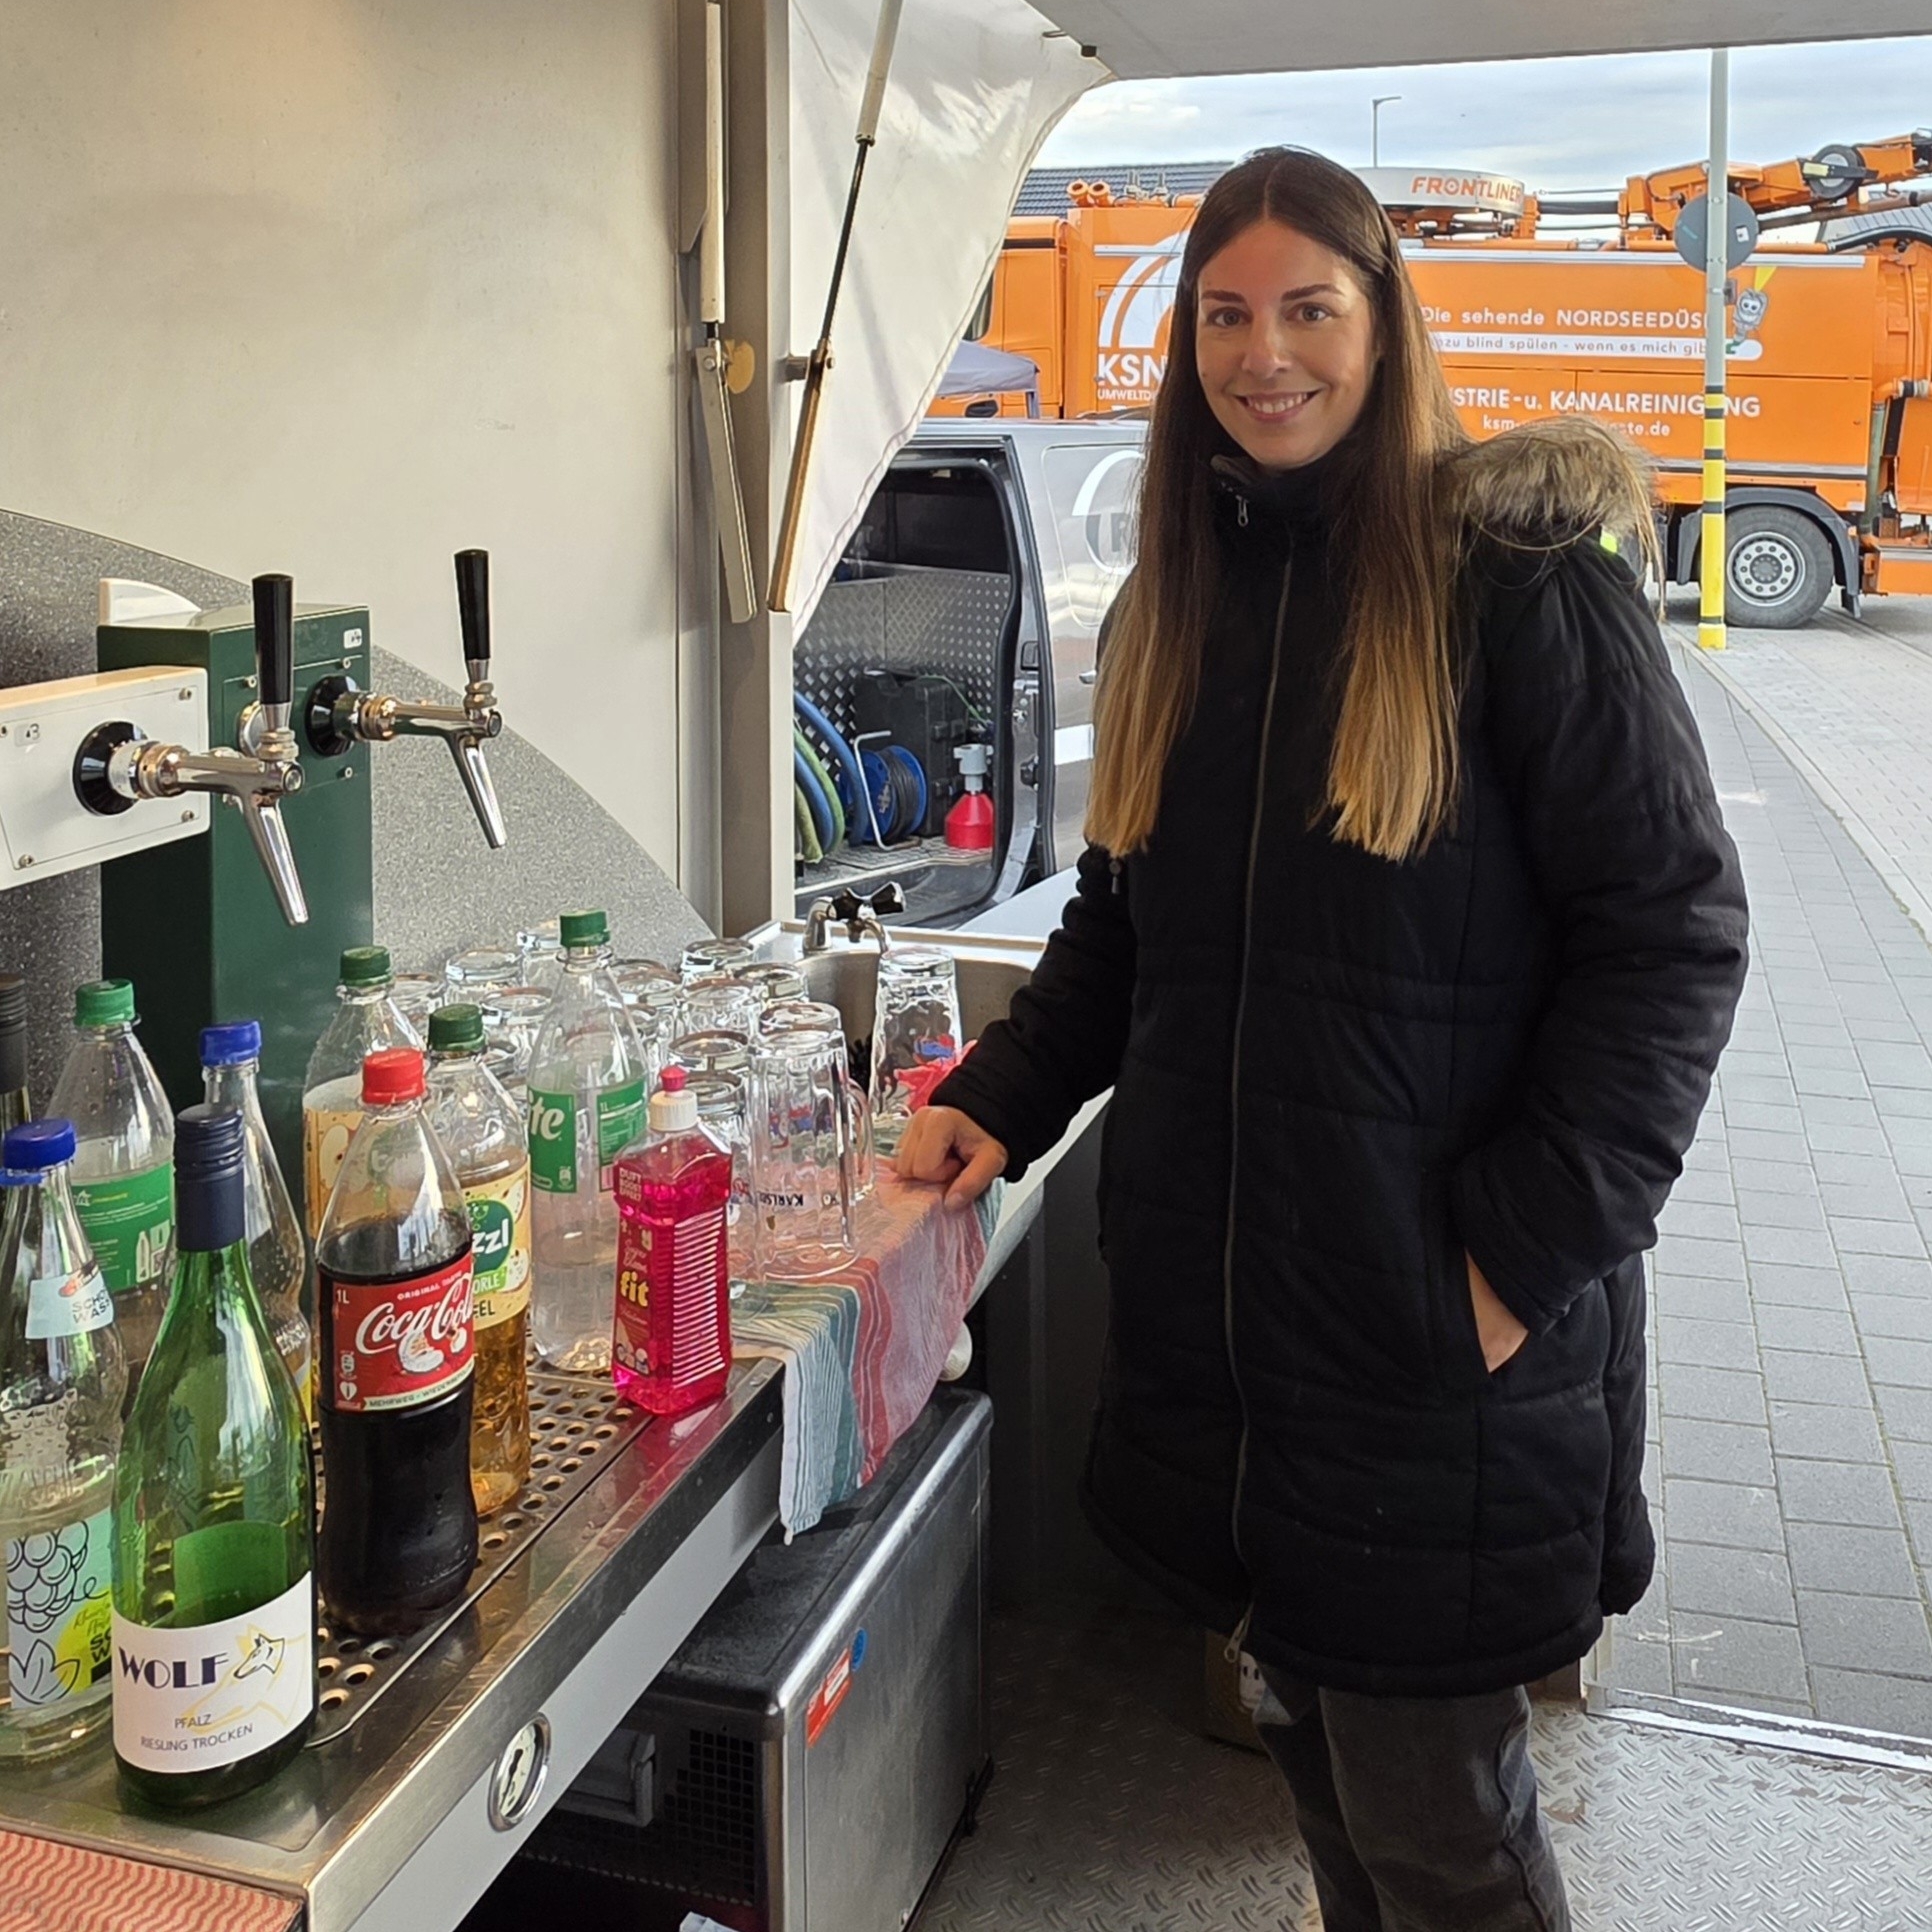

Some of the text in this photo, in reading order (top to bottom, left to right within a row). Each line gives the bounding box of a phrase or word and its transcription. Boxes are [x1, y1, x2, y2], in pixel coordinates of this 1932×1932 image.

[1420, 306, 1707, 330] Die sehende NORDSEEDÜS
[1466, 336, 1503, 348] blind
[1509, 338, 1557, 351] spülen
[1575, 341, 1613, 351] wenn
[1620, 343, 1636, 352] es
[1642, 341, 1676, 353] mich
[1097, 389, 1155, 401] UMWELTD
[1550, 390, 1761, 417] KANALREINIGNG
[472, 1218, 509, 1254] zzl
[472, 1275, 501, 1296] ORLE
[620, 1270, 649, 1307] fit
[118, 1646, 229, 1689] WOLF
[174, 1713, 213, 1730] PFALZ
[140, 1722, 254, 1751] RIESLING TROCKEN
